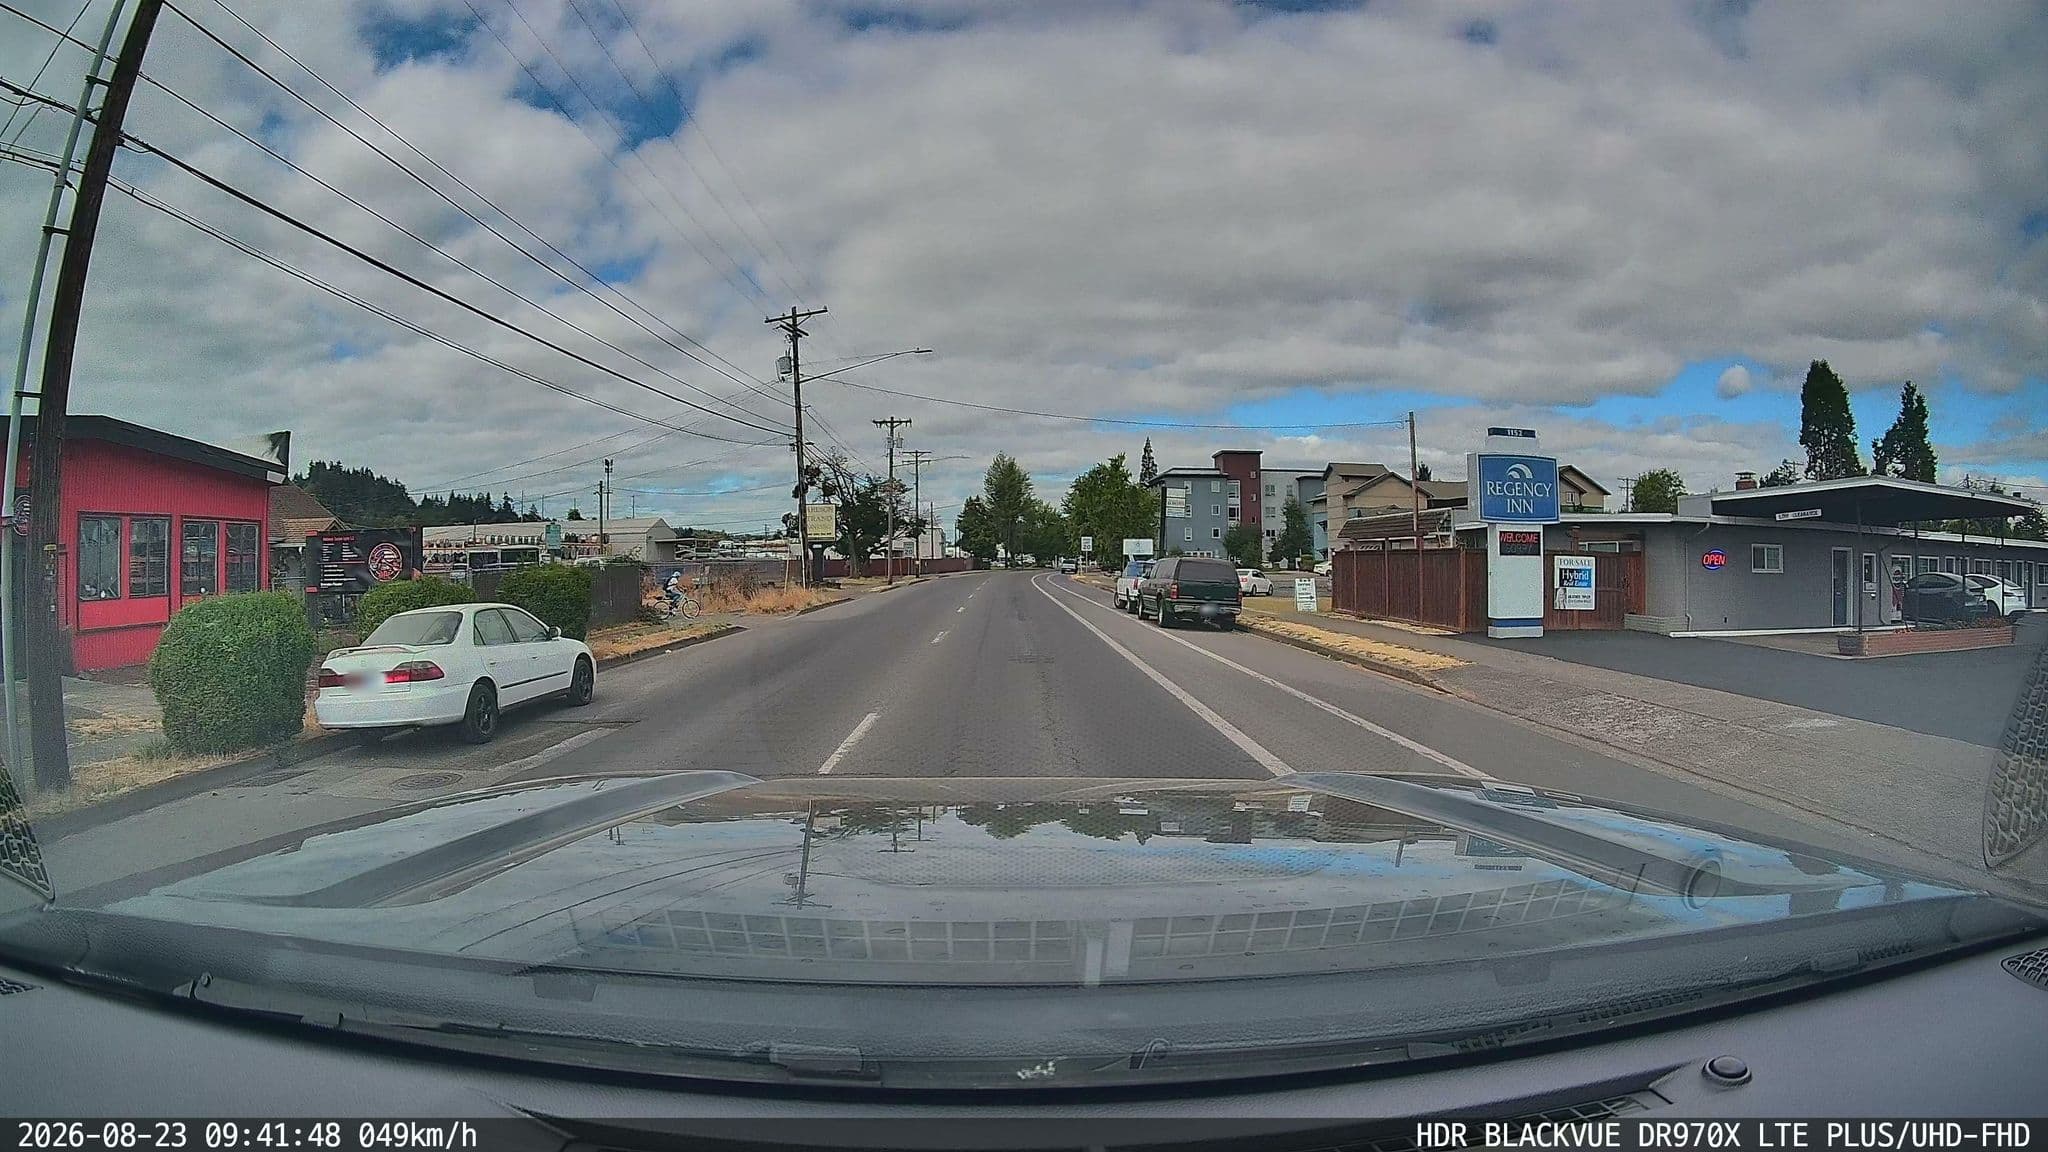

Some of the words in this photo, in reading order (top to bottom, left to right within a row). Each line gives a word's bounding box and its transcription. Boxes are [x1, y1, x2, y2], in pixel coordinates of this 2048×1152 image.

[1507, 429, 1523, 437] 1152
[1487, 481, 1553, 497] REGENCY
[1507, 498, 1534, 514] INN
[1500, 532, 1539, 543] WELCOME
[1559, 558, 1574, 566] FOR
[1574, 558, 1591, 567] SALE
[1703, 554, 1726, 565] OPEN
[1562, 569, 1589, 581] Hybrid
